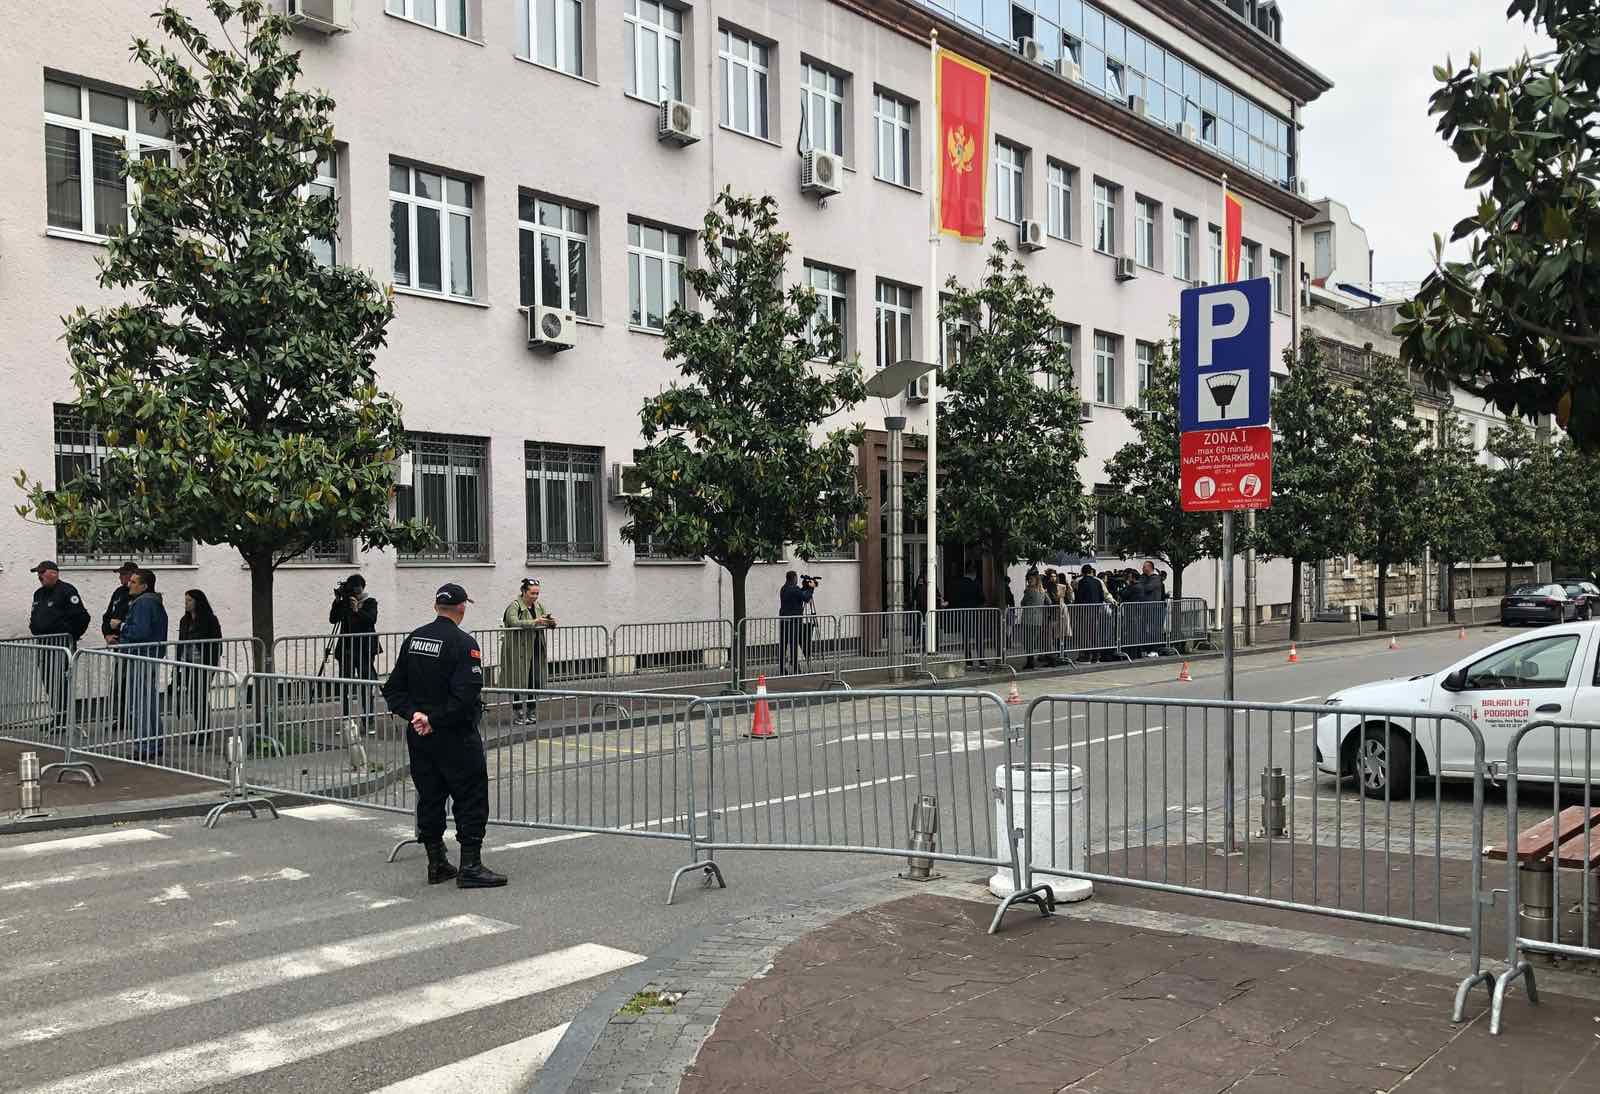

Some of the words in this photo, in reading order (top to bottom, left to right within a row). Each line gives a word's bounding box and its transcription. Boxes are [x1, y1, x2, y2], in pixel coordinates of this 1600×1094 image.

[1198, 289, 1250, 367] P
[1204, 431, 1238, 445] ZONA
[1242, 430, 1247, 442] I
[1215, 446, 1226, 454] 60
[1227, 445, 1253, 453] minuta
[1183, 455, 1221, 465] NAPLATA
[1222, 452, 1269, 463] PARKIRANJA
[411, 640, 440, 654] POLICIJA
[1482, 698, 1512, 707] BALKAN
[1514, 698, 1530, 707] LIFT
[1484, 709, 1529, 718] PODGORICA
